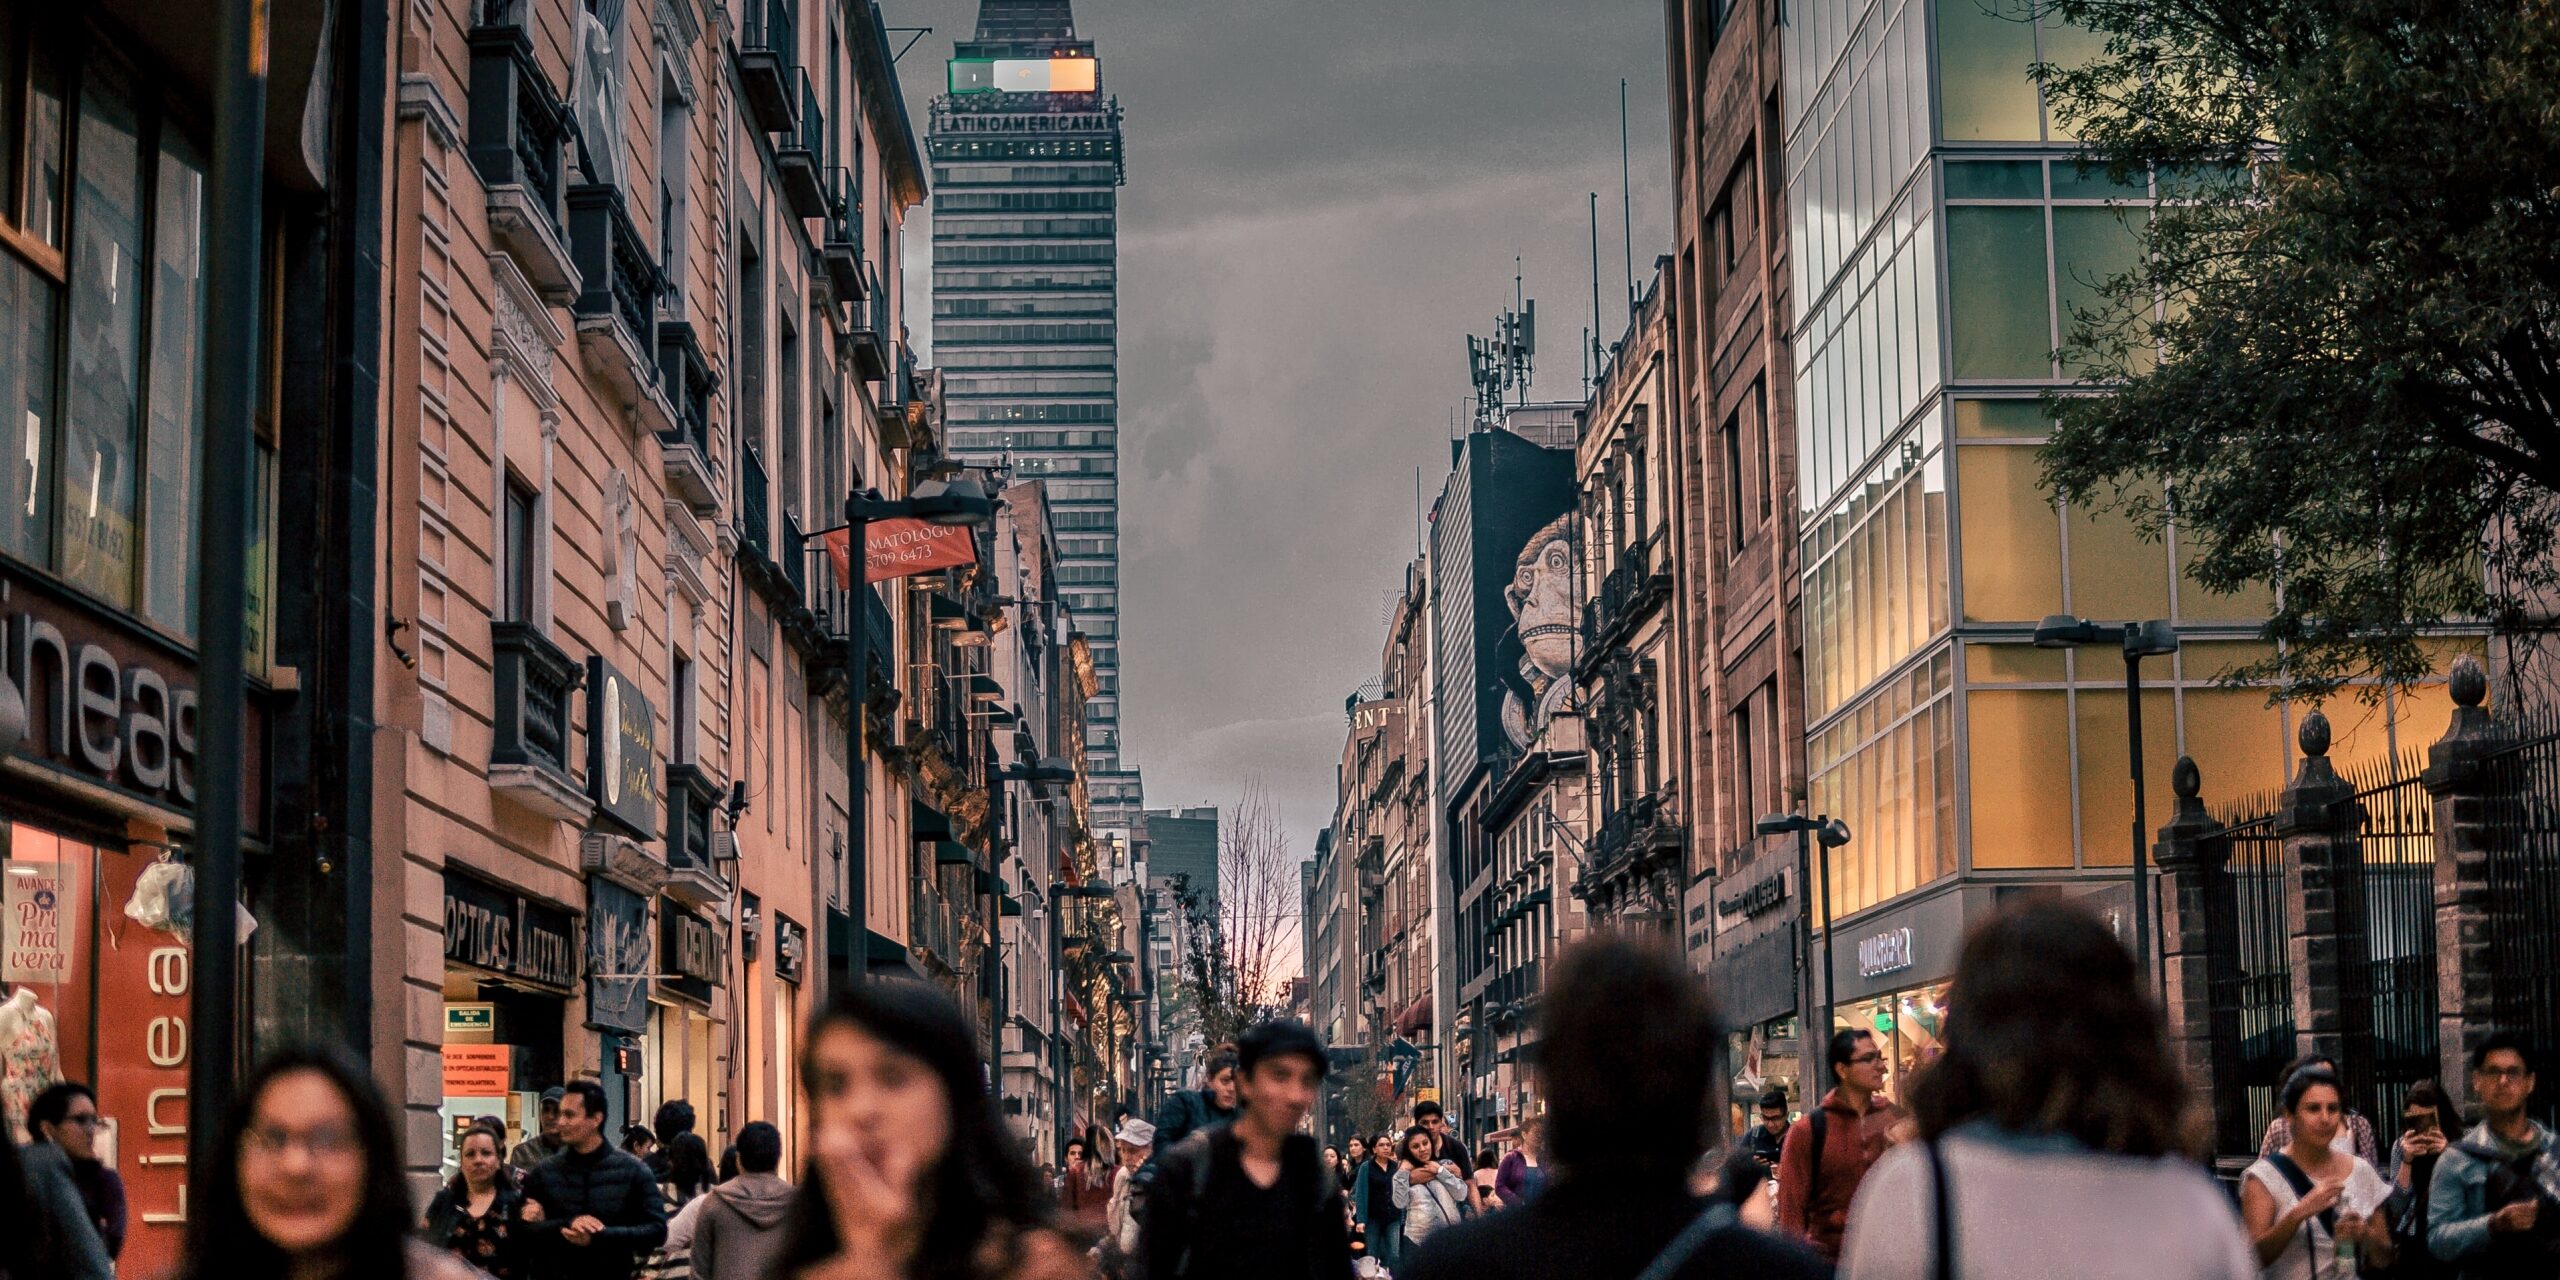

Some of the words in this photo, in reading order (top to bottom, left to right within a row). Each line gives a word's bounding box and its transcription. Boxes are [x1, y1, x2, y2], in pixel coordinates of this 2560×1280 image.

[940, 115, 1104, 132] LATINOAMERICANA
[841, 524, 956, 558] DMATÓLOGO
[867, 551, 896, 570] 5709
[900, 544, 932, 562] 6473
[17, 877, 65, 892] AVANCES
[17, 901, 57, 928] Pri
[20, 930, 57, 949] ma
[445, 895, 510, 970] OPTICAS
[11, 951, 65, 970] vera
